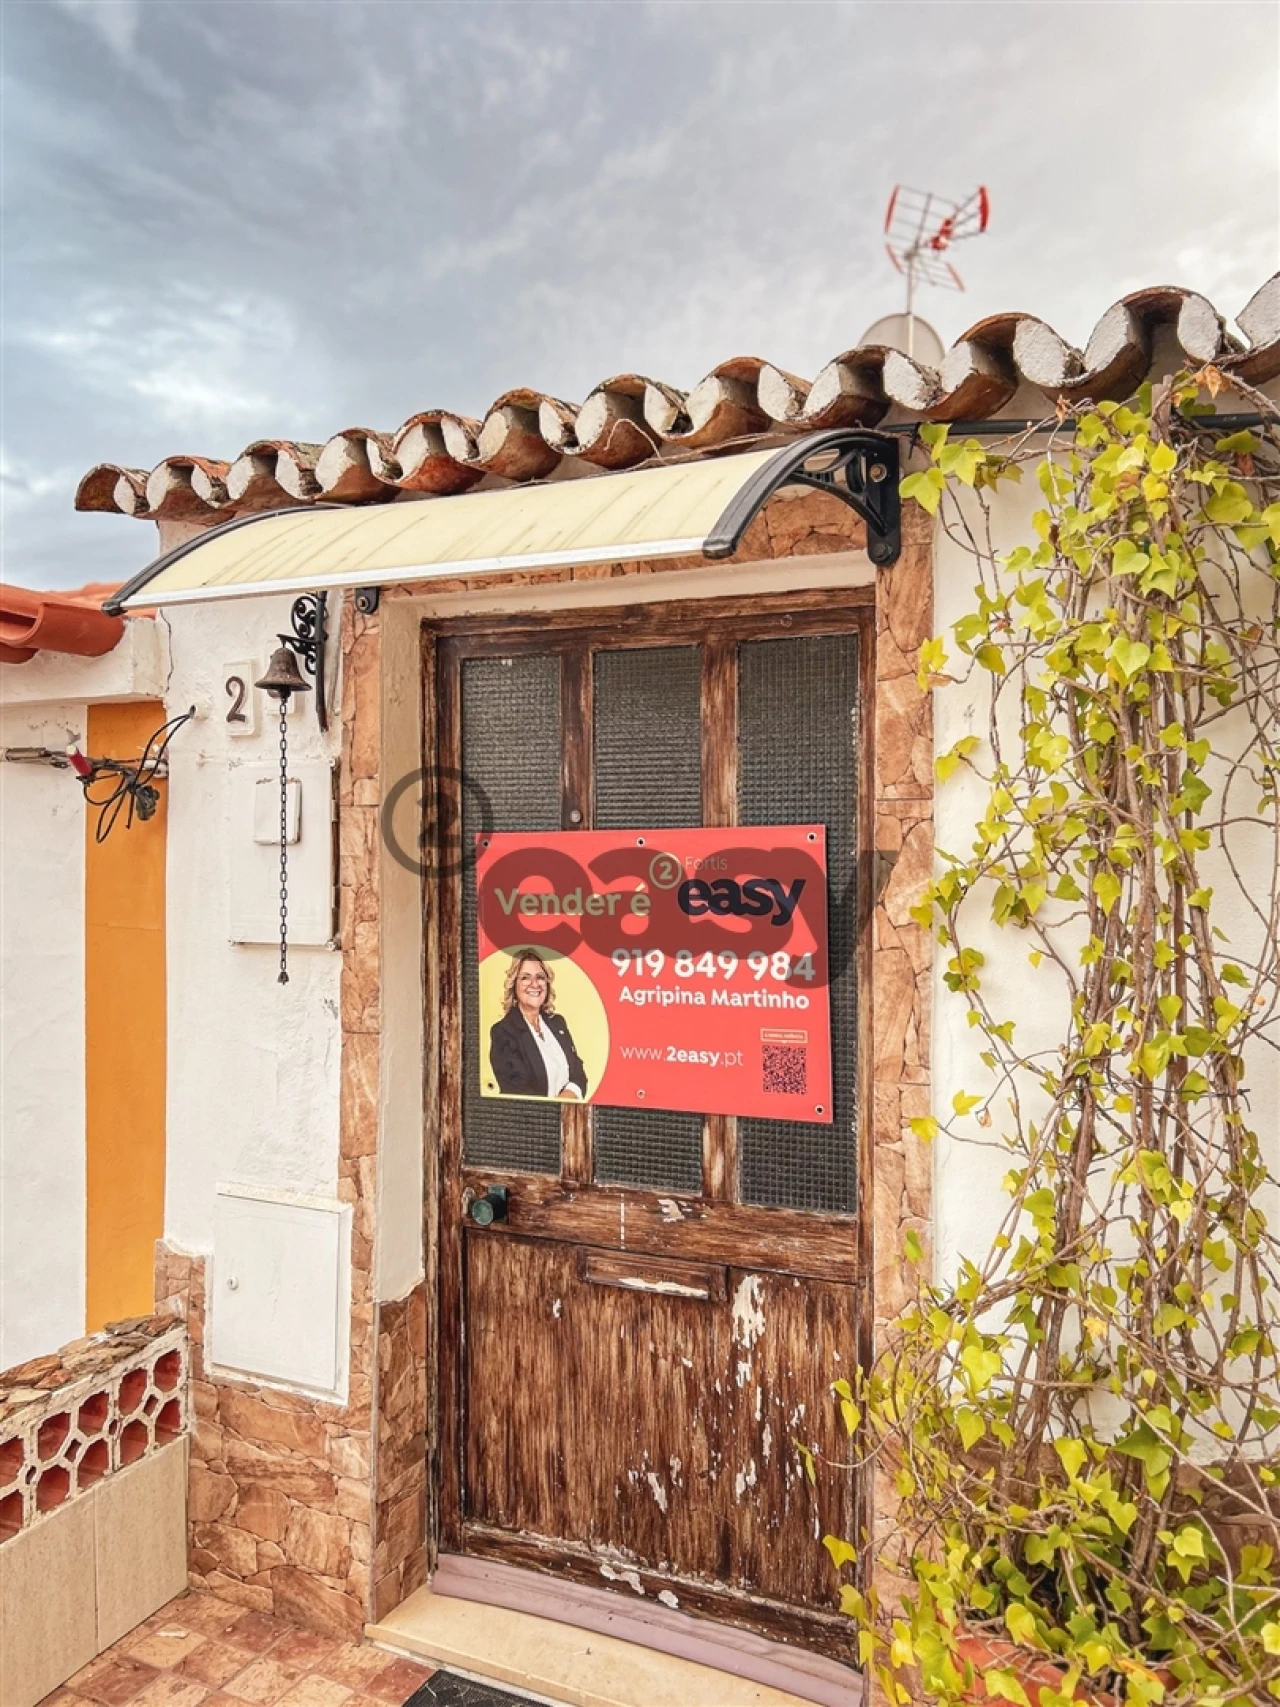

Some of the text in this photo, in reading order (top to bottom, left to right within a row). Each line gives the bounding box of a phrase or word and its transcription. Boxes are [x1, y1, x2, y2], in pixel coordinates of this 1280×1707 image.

[226, 676, 246, 722] 2
[685, 856, 728, 870] Fortis
[494, 862, 806, 926] Vender é 2 easy
[611, 948, 816, 981] 919 849 984
[619, 985, 809, 1009] Agripina Martinho
[619, 1046, 743, 1068] www.2easy.pt
